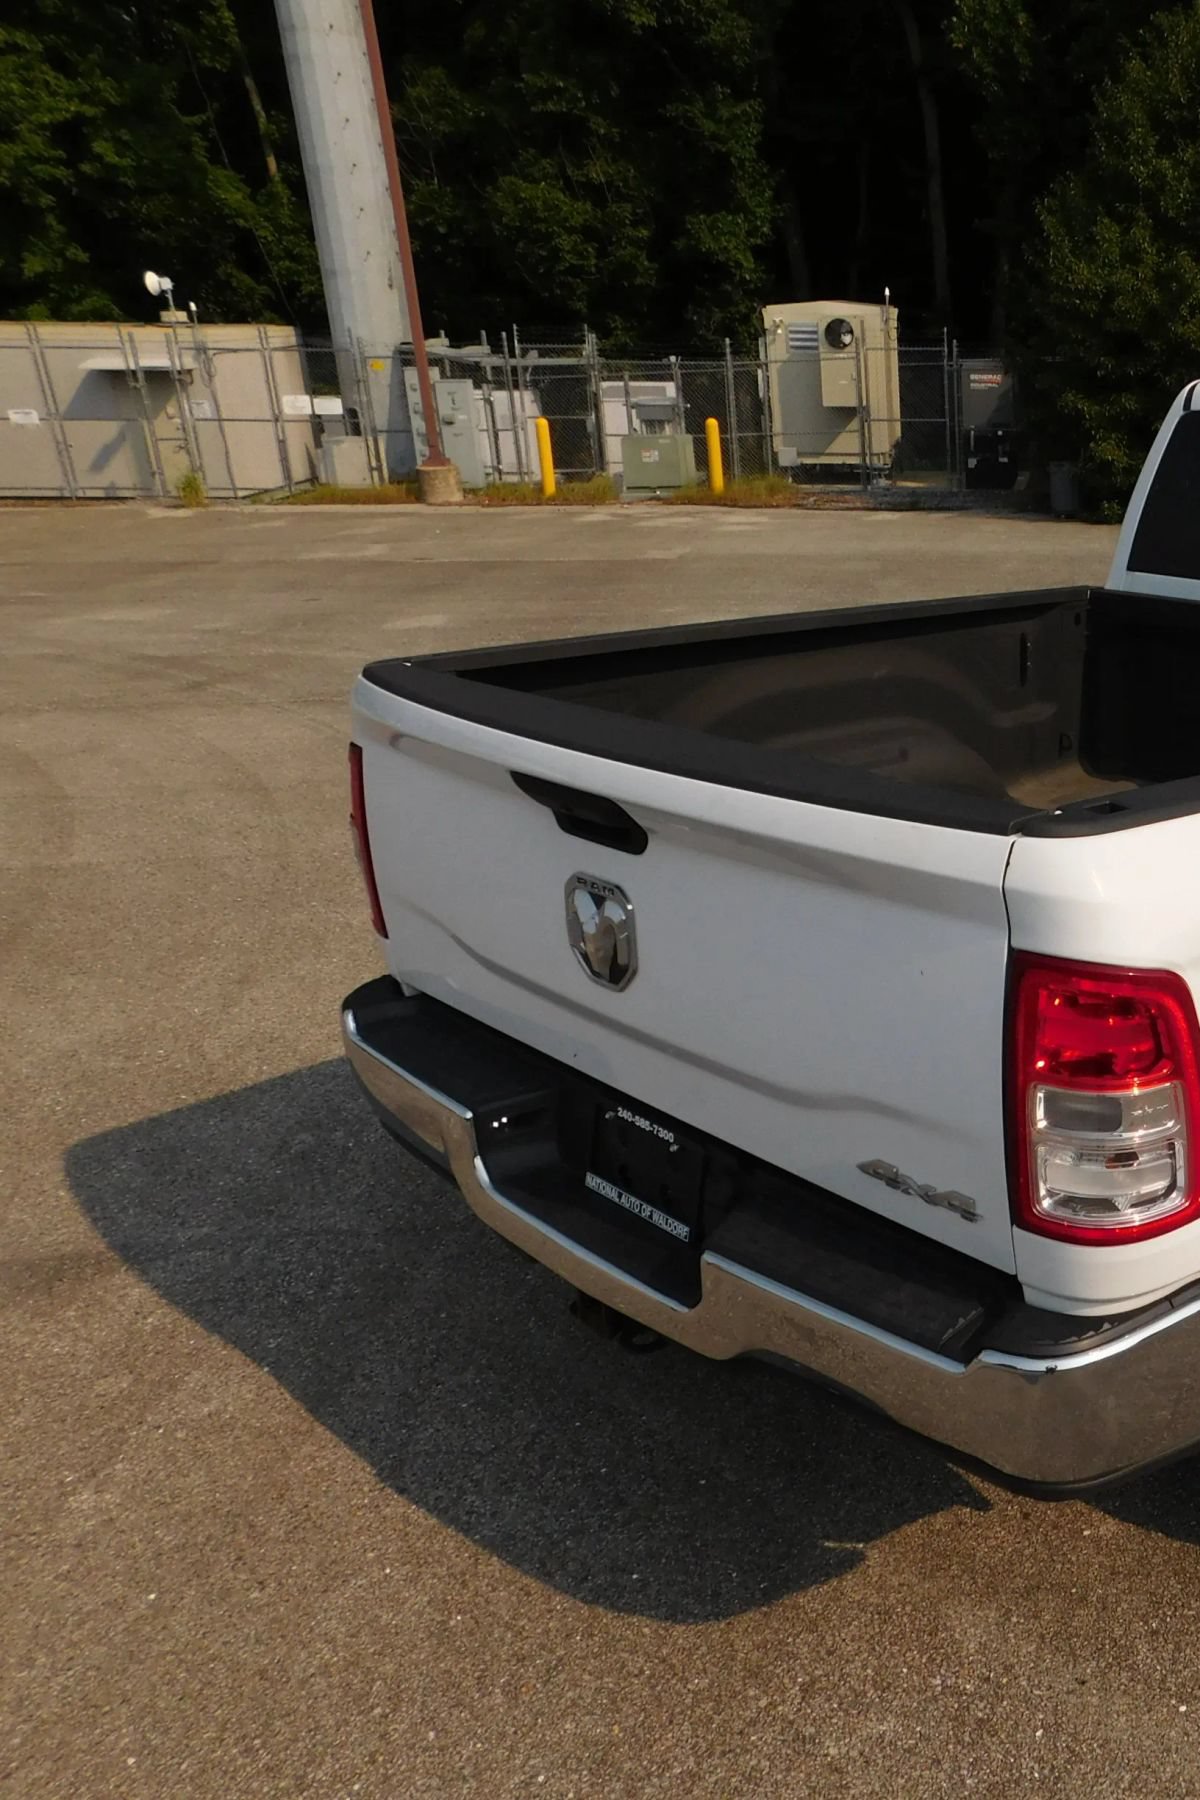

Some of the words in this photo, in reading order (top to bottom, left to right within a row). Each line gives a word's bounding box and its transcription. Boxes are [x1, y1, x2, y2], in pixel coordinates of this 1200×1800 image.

[617, 1106, 674, 1143] 240-585-7300
[587, 1174, 620, 1202] NATIONAL
[620, 1194, 641, 1212] AUTO
[641, 1205, 652, 1219] OF
[652, 1208, 689, 1238] WALDORF
